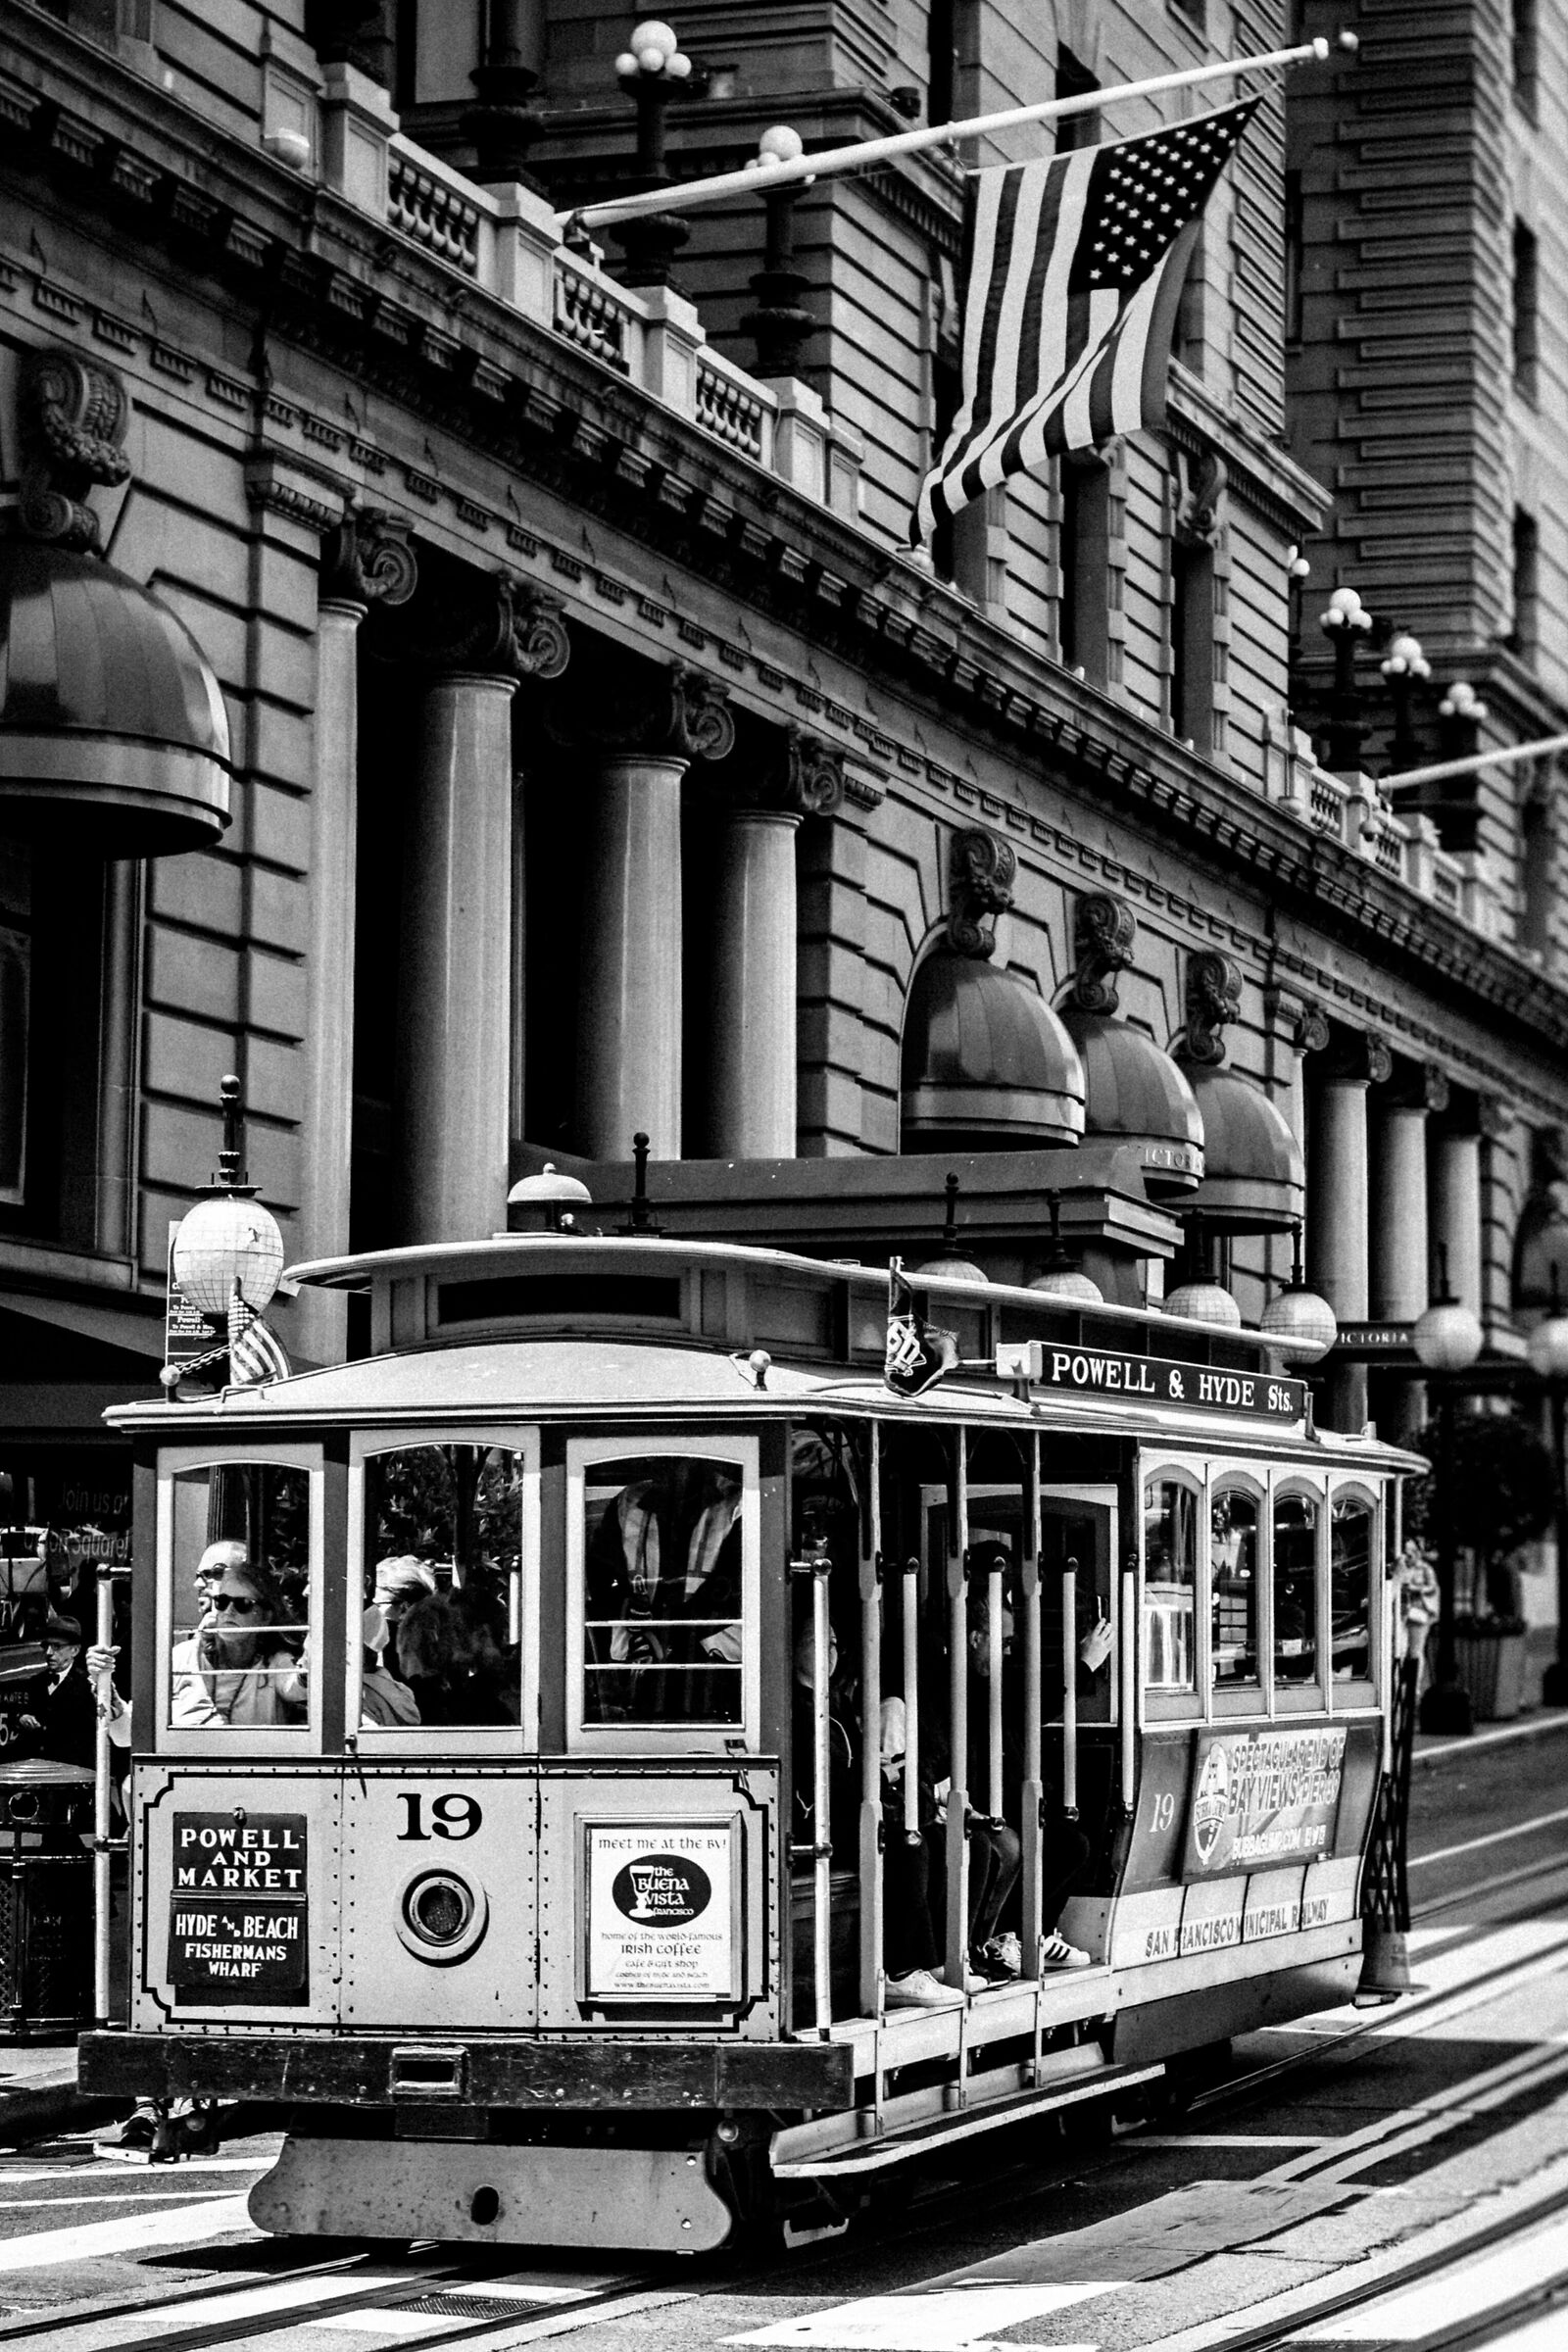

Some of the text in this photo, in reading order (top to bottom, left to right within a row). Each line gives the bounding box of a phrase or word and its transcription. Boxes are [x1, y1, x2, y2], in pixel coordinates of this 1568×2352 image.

[1340, 1332, 1408, 1344] ICTORIA
[1053, 1352, 1294, 1412] POWELL & HYDE Sts.
[1227, 1772, 1256, 1815] BAY
[396, 1792, 482, 1840] 19
[1149, 1792, 1175, 1833] 19
[180, 1829, 300, 1849] POWELL
[212, 1851, 271, 1866] AND
[177, 1868, 302, 1887] MARKET
[175, 1914, 218, 1936] HYDE
[243, 1916, 298, 1939] BEACH
[184, 1942, 287, 1961] FISHERMANS
[1146, 1930, 1170, 1958] SAN
[208, 1961, 262, 1978] WHARF
